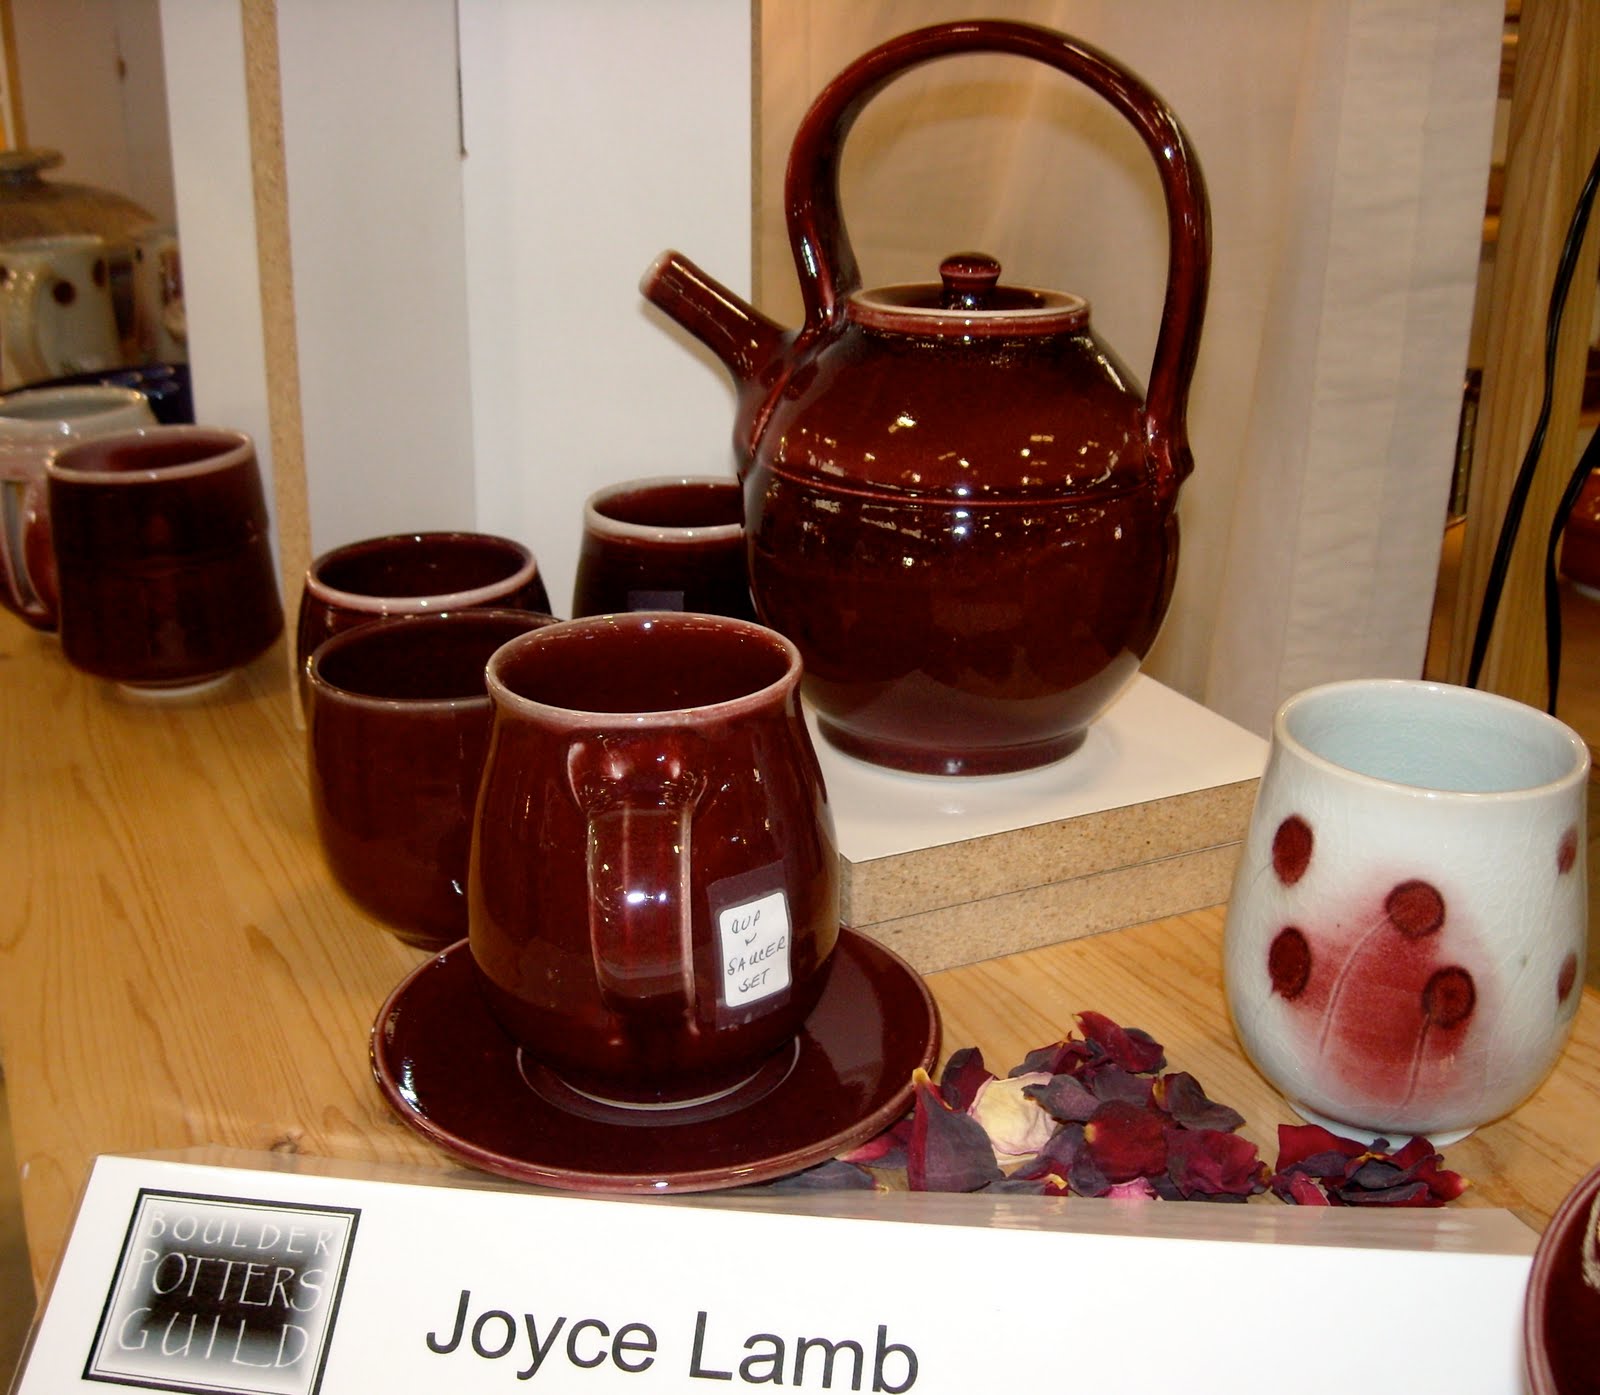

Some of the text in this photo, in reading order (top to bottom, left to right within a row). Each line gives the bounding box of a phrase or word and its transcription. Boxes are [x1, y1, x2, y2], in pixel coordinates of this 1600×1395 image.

[727, 936, 786, 976] SAUCER
[738, 968, 770, 993] SET
[148, 1209, 335, 1255] BOULDER
[132, 1248, 327, 1313] POTTERS
[119, 1308, 309, 1368] GUILD
[426, 1289, 919, 1395] Joyce Lamb
